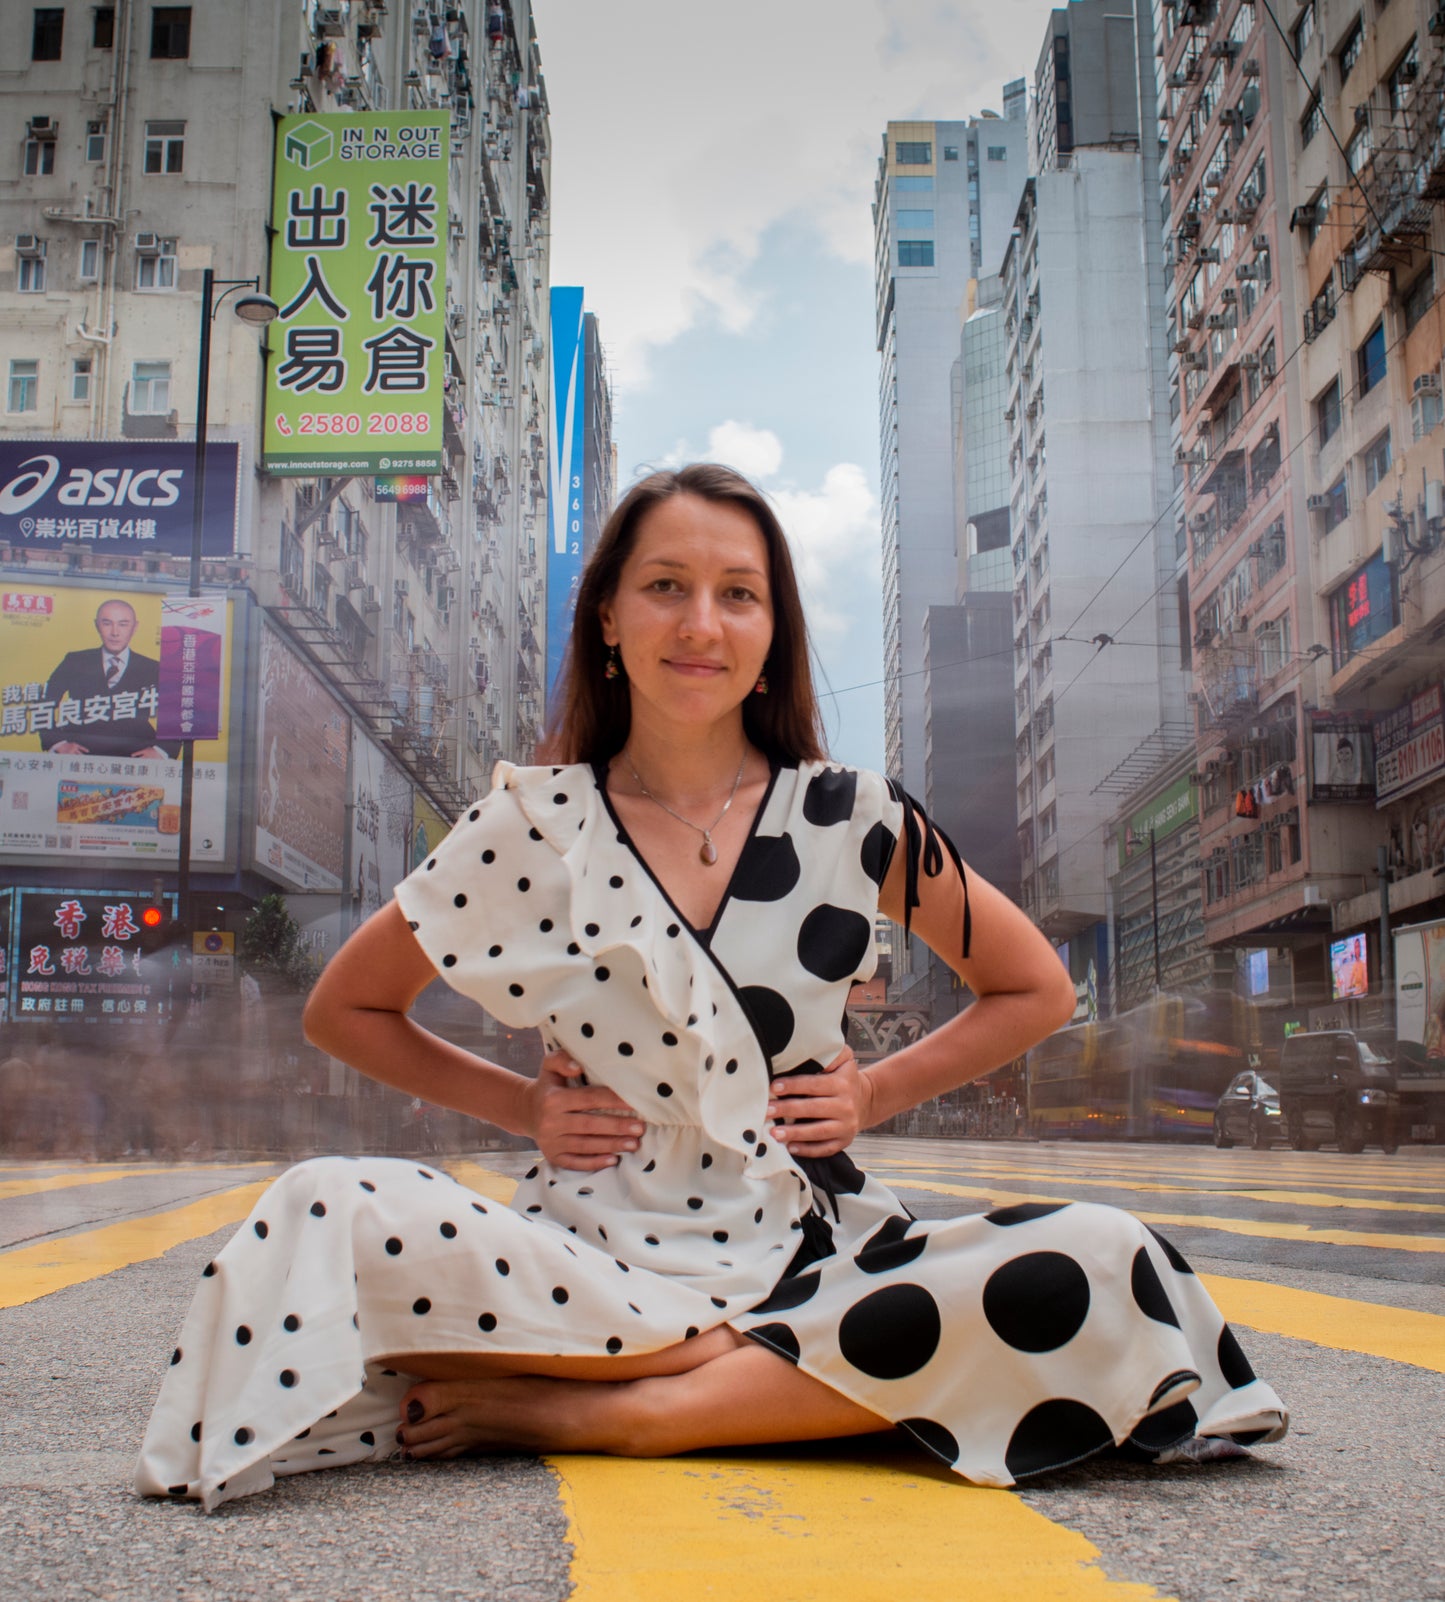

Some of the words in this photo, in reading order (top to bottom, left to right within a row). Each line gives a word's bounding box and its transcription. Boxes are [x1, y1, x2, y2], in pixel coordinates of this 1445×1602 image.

[343, 128, 363, 142] IN
[374, 128, 387, 141] N
[399, 127, 441, 141] OUT
[340, 144, 440, 159] STORAGE
[277, 185, 349, 392] 出入易
[363, 183, 436, 392] 迷你倉
[299, 414, 360, 434] 2580
[368, 413, 429, 433] 2088
[267, 460, 369, 470] www.innoutstorage.com
[392, 459, 414, 468] 9275
[35, 518, 157, 539] 崇光百貨4樓
[180, 633, 197, 733] 香港亞洲國際都會
[54, 899, 140, 941] 香港
